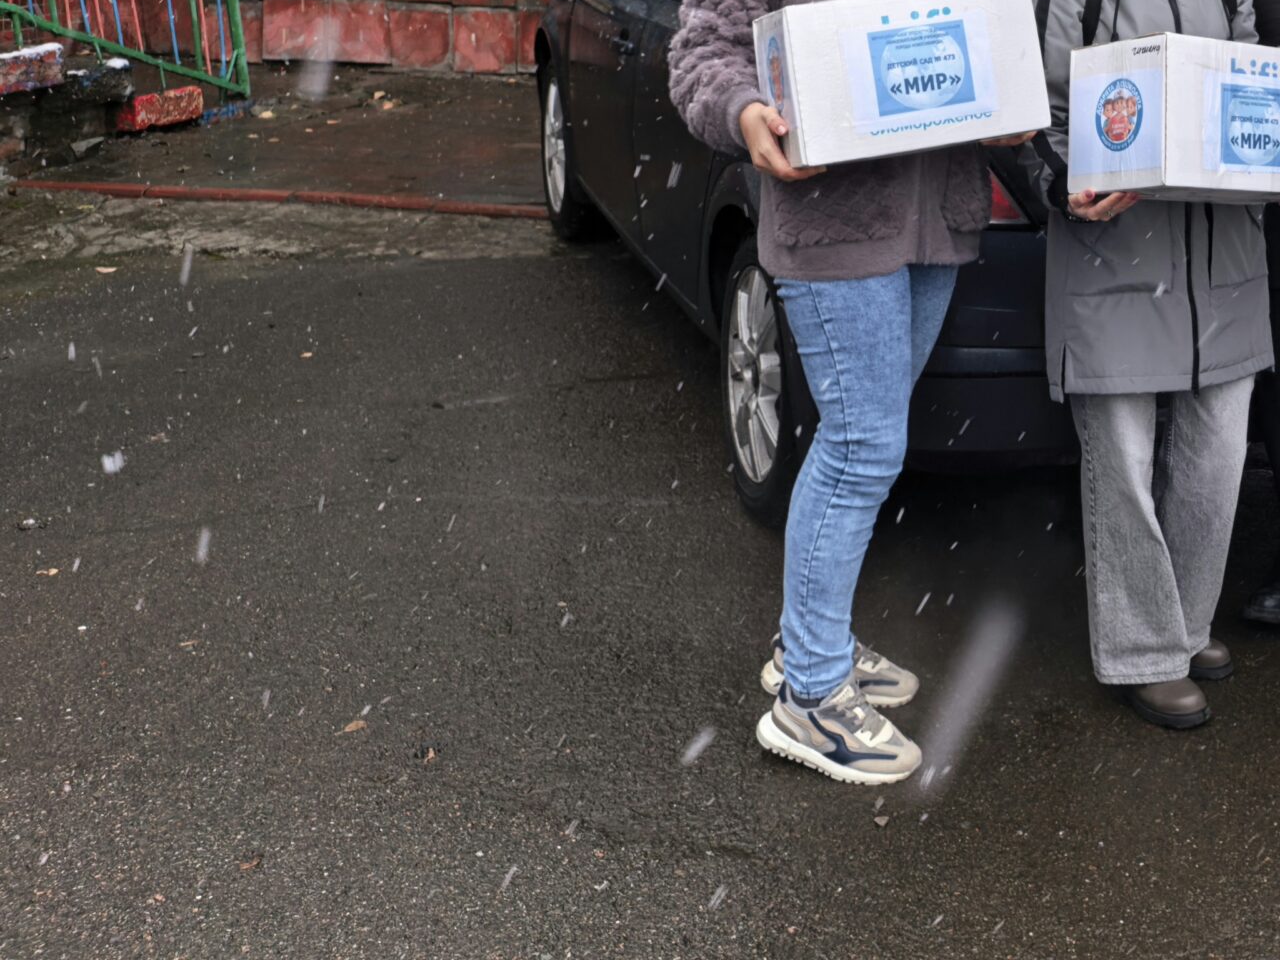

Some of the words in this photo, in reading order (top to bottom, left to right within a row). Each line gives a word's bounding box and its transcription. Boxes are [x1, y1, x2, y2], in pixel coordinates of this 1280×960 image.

[887, 57, 918, 71] ДЕТСКИЙ
[919, 57, 934, 66] САД
[943, 54, 956, 62] 473
[890, 72, 962, 96] «МИР»
[1230, 132, 1280, 150] «МИР»
